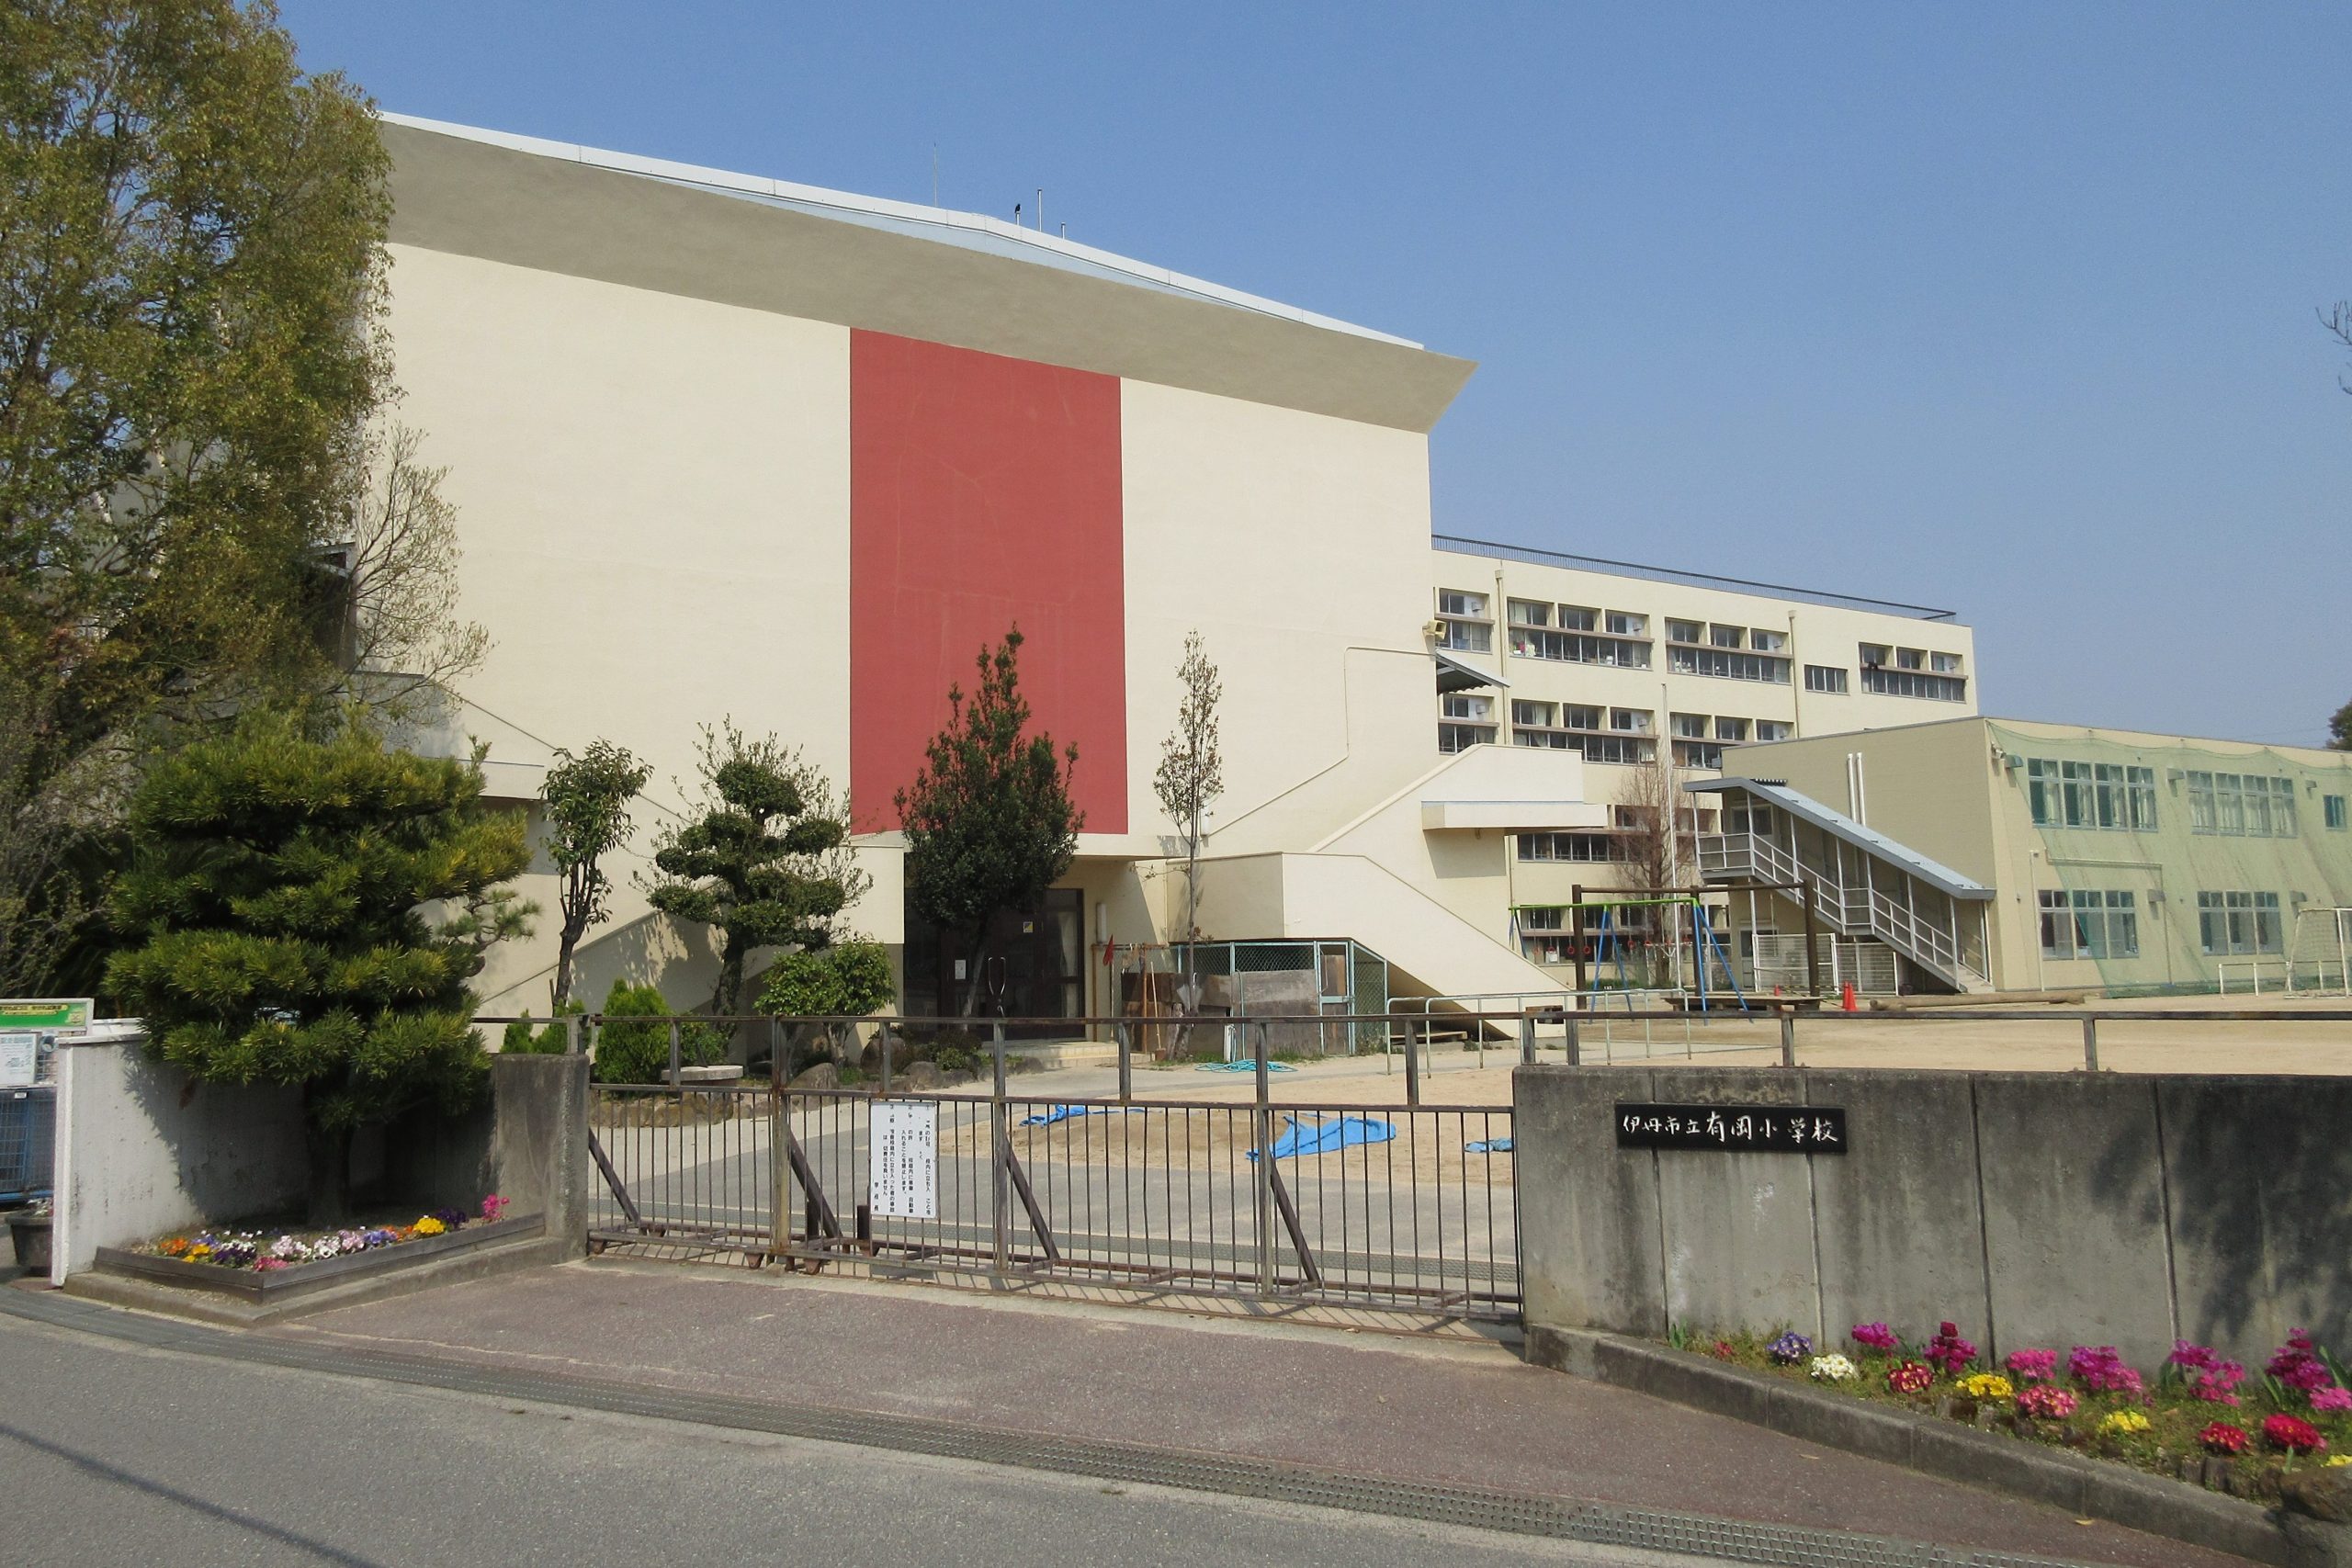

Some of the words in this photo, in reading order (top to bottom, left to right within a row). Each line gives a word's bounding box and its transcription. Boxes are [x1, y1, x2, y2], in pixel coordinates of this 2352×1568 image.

[1623, 1111, 1838, 1144] 伊丹市立有岡小学校
